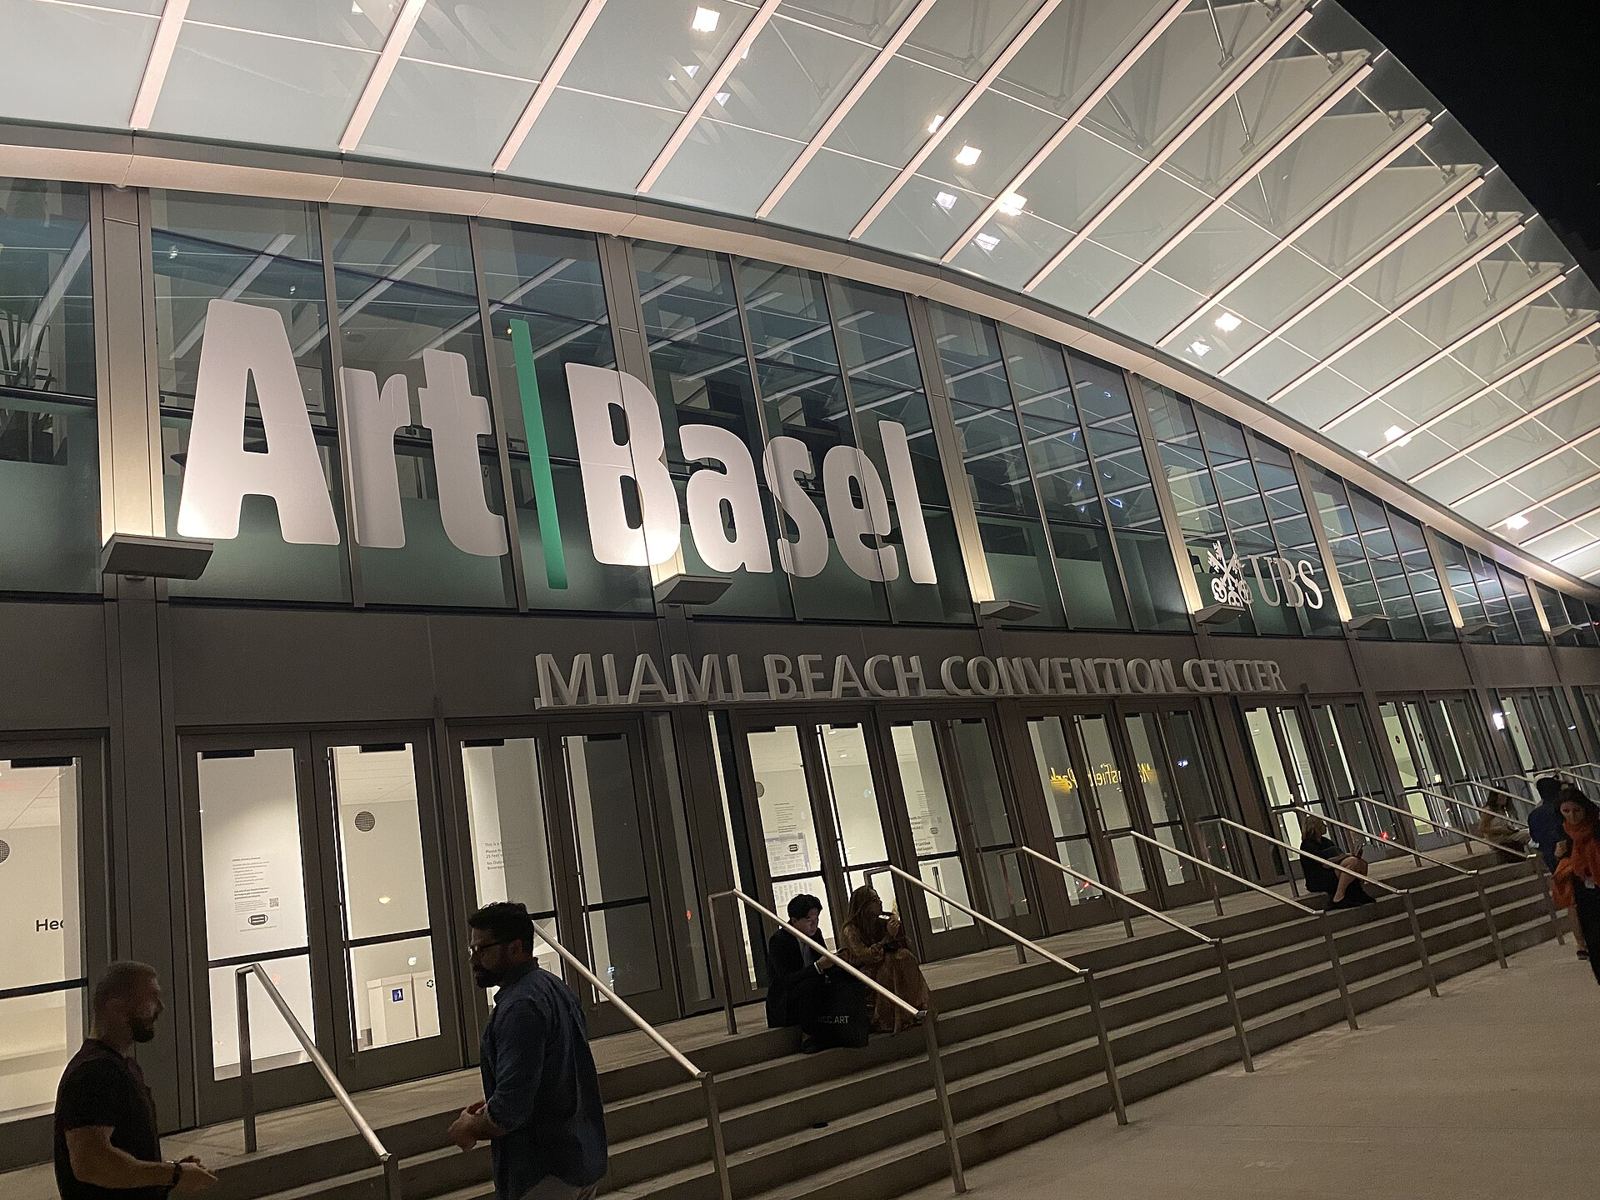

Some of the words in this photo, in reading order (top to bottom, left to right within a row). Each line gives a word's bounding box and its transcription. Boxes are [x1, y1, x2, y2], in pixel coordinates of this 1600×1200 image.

[177, 299, 508, 556] Art
[565, 361, 937, 584] Basel
[1247, 554, 1323, 609] UBS
[535, 653, 745, 705] MIAMI
[763, 654, 927, 700] BEACH
[941, 655, 1177, 696] CONVENTION
[1183, 658, 1288, 693] CENTER
[834, 1015, 850, 1024] ART
